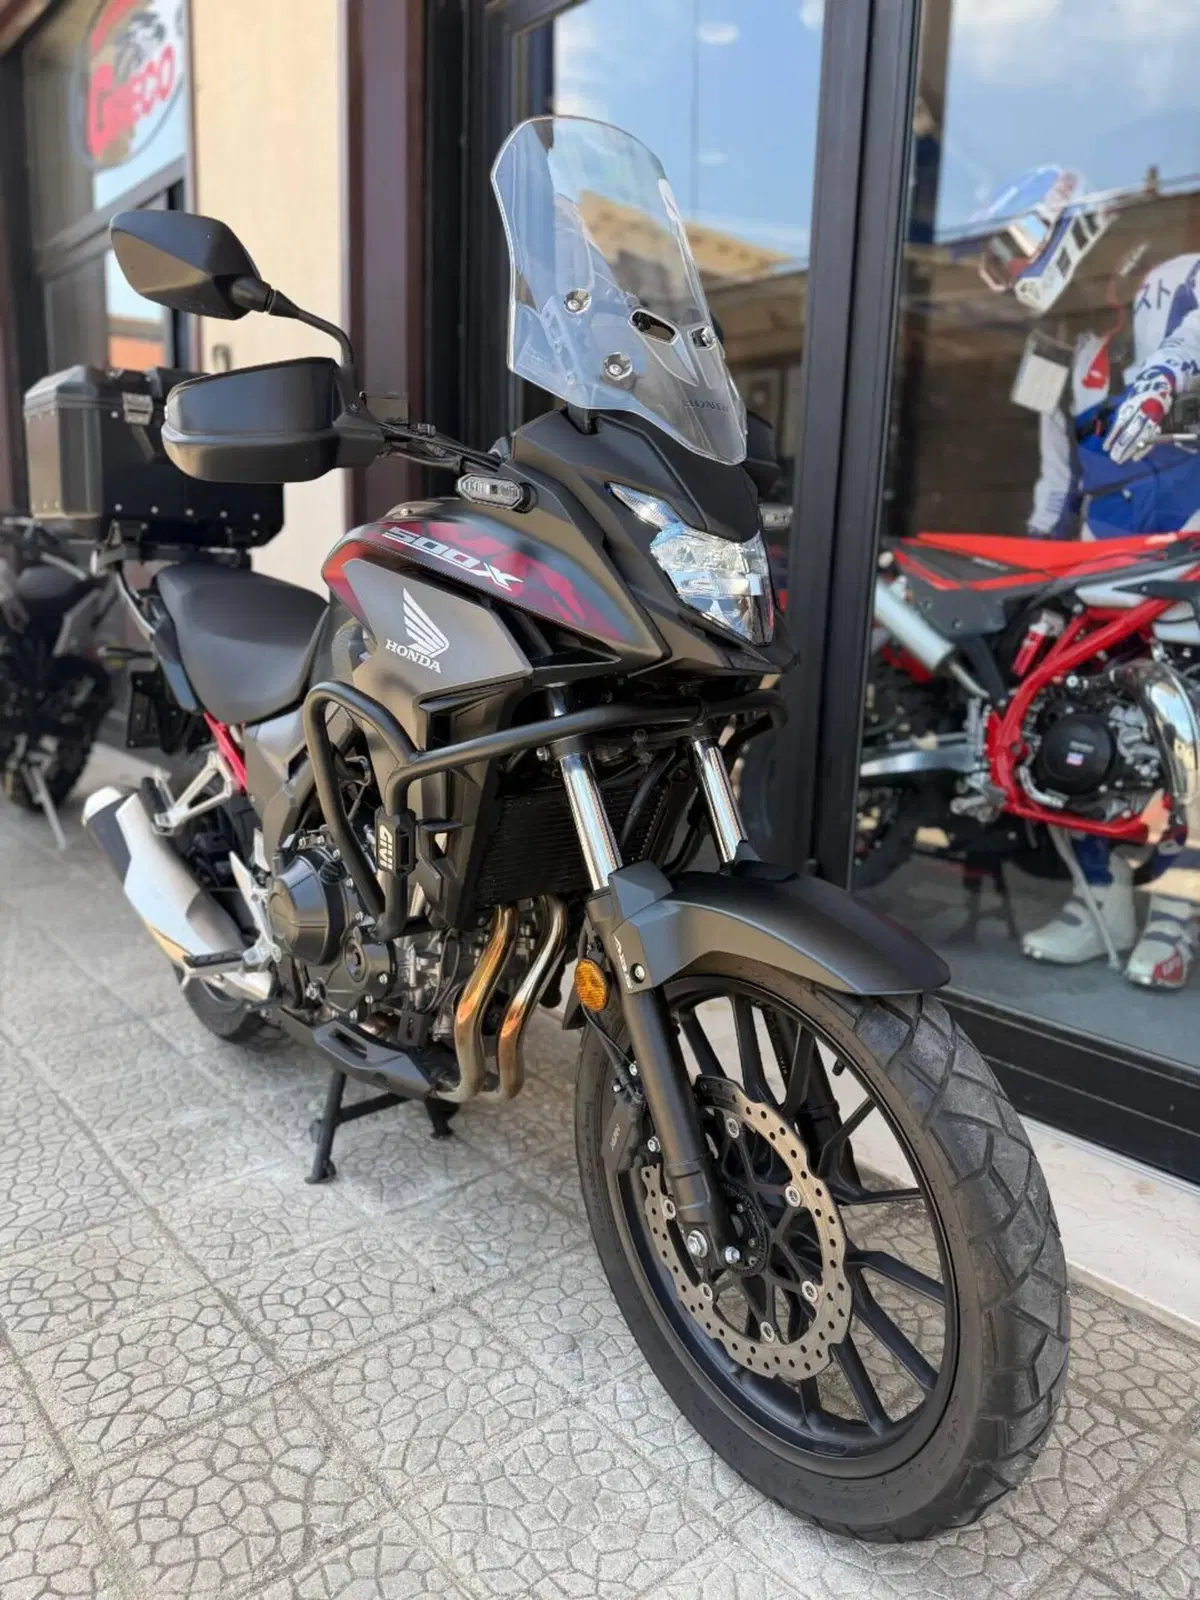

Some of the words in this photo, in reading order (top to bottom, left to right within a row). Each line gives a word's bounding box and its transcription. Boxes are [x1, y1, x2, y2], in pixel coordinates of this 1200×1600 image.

[381, 526, 524, 592] 500X
[385, 638, 443, 675] HONDA
[379, 824, 393, 871] GIVI
